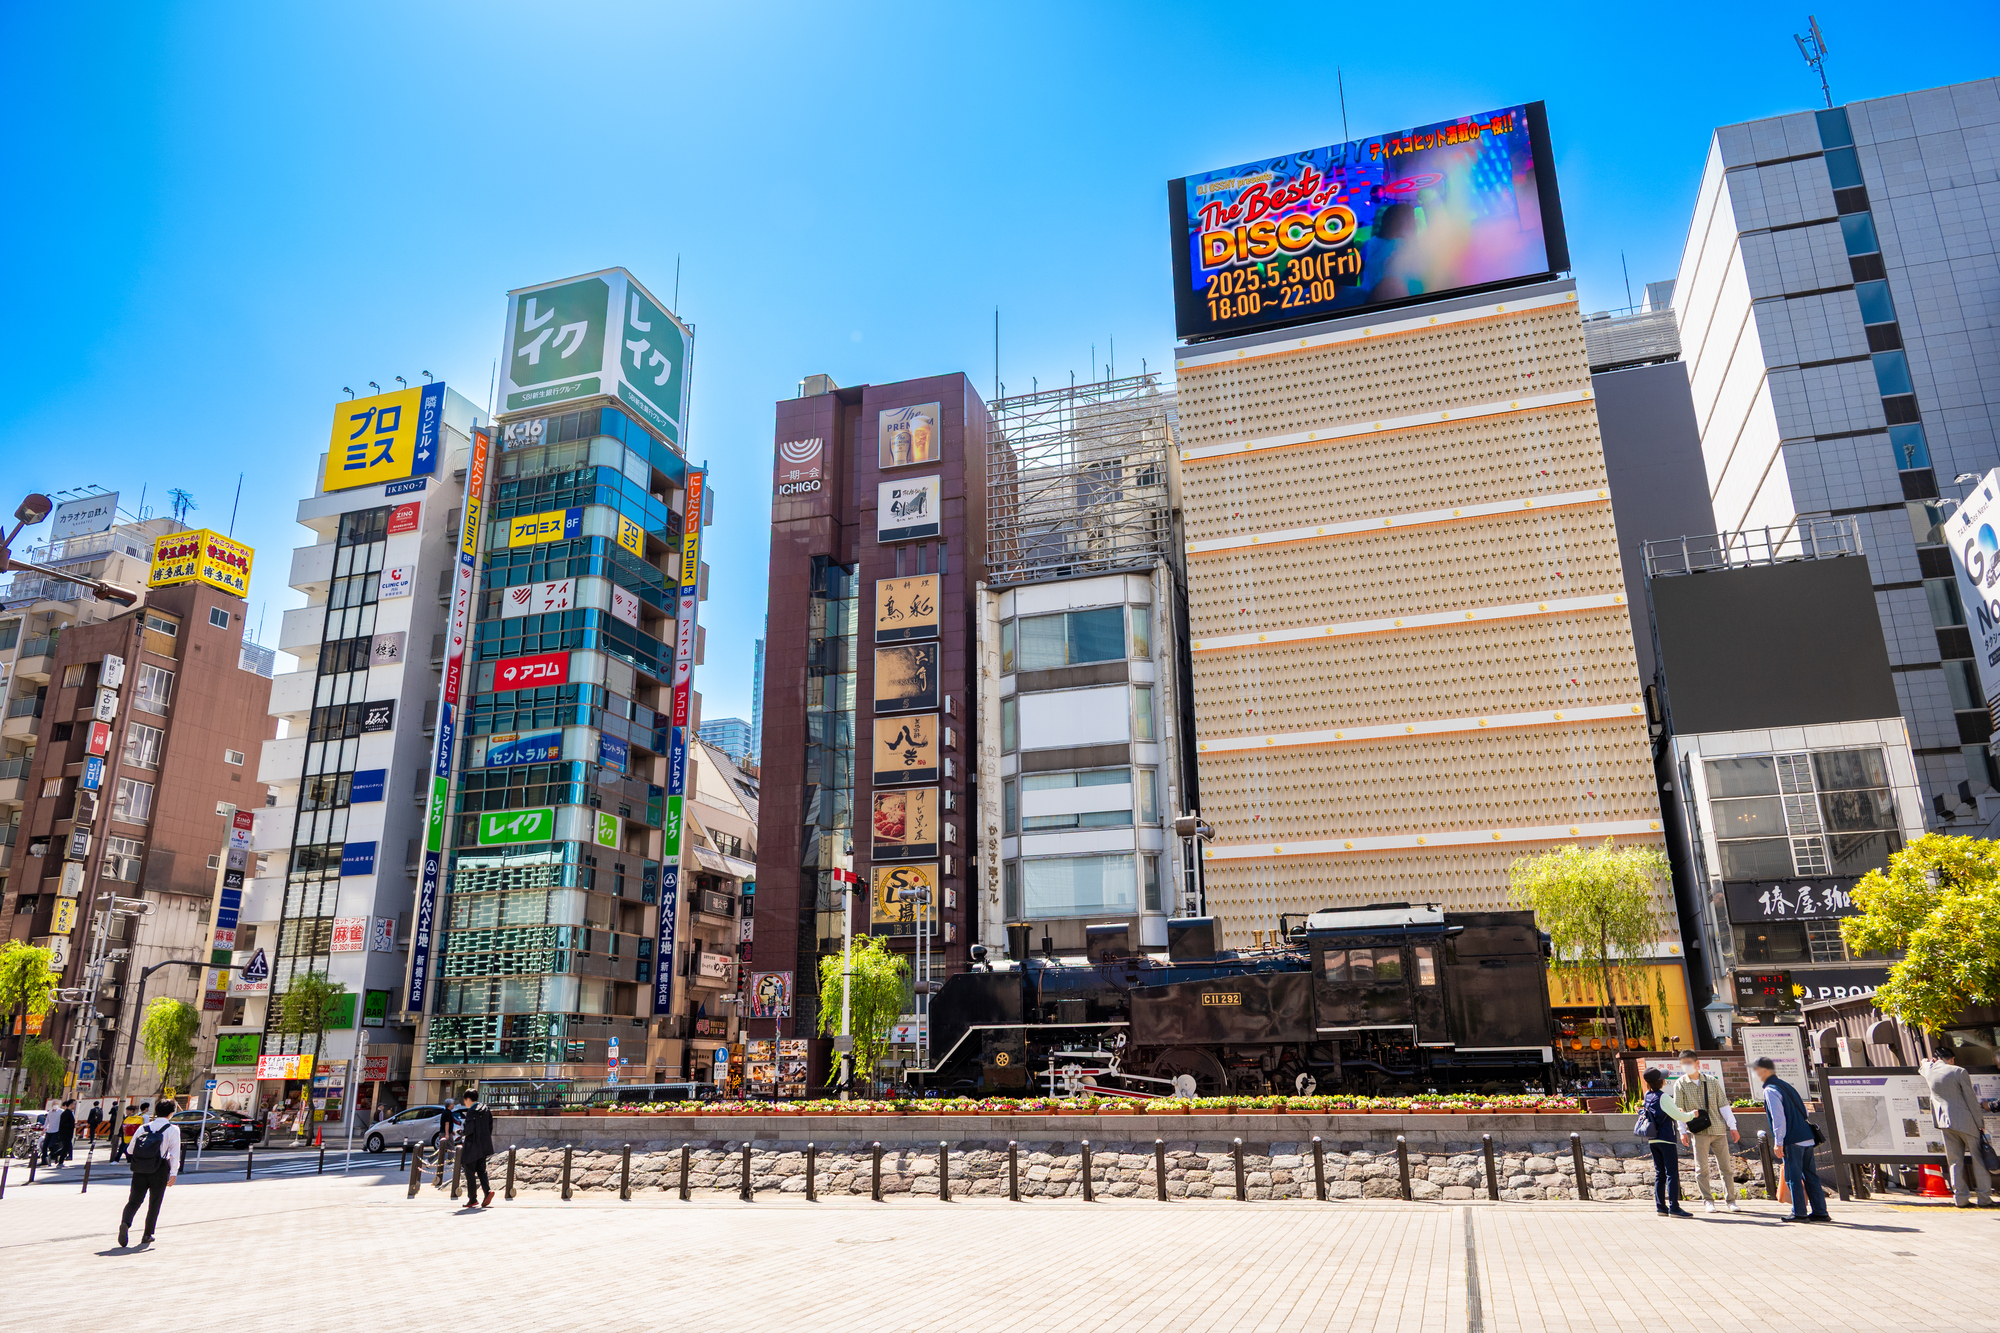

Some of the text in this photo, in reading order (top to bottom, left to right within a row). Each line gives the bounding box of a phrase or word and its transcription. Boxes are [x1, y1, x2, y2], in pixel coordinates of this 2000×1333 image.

[1370, 114, 1513, 161] ディスコヒット満載の一夜!!
[1237, 173, 1272, 188] presents
[1198, 167, 1338, 231] The Best of
[1201, 207, 1355, 269] DISCO
[1206, 248, 1362, 299] 2025.5.30(Fri)
[522, 383, 582, 402] SBI新生銀行グループ
[420, 396, 437, 448] 隣りビル
[504, 419, 543, 441] K-16
[781, 467, 820, 480] 一期一会
[388, 481, 423, 494] IKENO-7
[779, 480, 821, 495] ICHIGO
[465, 504, 478, 548] プロミス
[515, 518, 580, 538] プロミス 8F
[906, 528, 912, 536] 7
[684, 538, 697, 580] プロミス
[448, 666, 458, 694] アコム
[520, 662, 560, 680] アコム
[676, 692, 686, 718] アコム
[440, 724, 450, 768] セントラル
[493, 748, 547, 765] セントラル
[602, 742, 626, 756] セントラル
[672, 746, 682, 788] セントラル
[902, 771, 909, 781] 2
[432, 794, 442, 825] レイク
[488, 812, 542, 836] レイク
[668, 811, 678, 840] レイク
[902, 846, 908, 856] 2
[1758, 884, 1852, 915] 椿屋珈
[214, 930, 235, 943] 麻雀
[333, 924, 364, 944] 麻雀
[412, 880, 435, 1002] かんべ土地 新橋支店
[658, 892, 676, 1004] かんべ土地 新橋支店
[1221, 994, 1240, 1004] 292
[366, 1008, 382, 1017] BAR
[237, 1083, 254, 1094] 150
